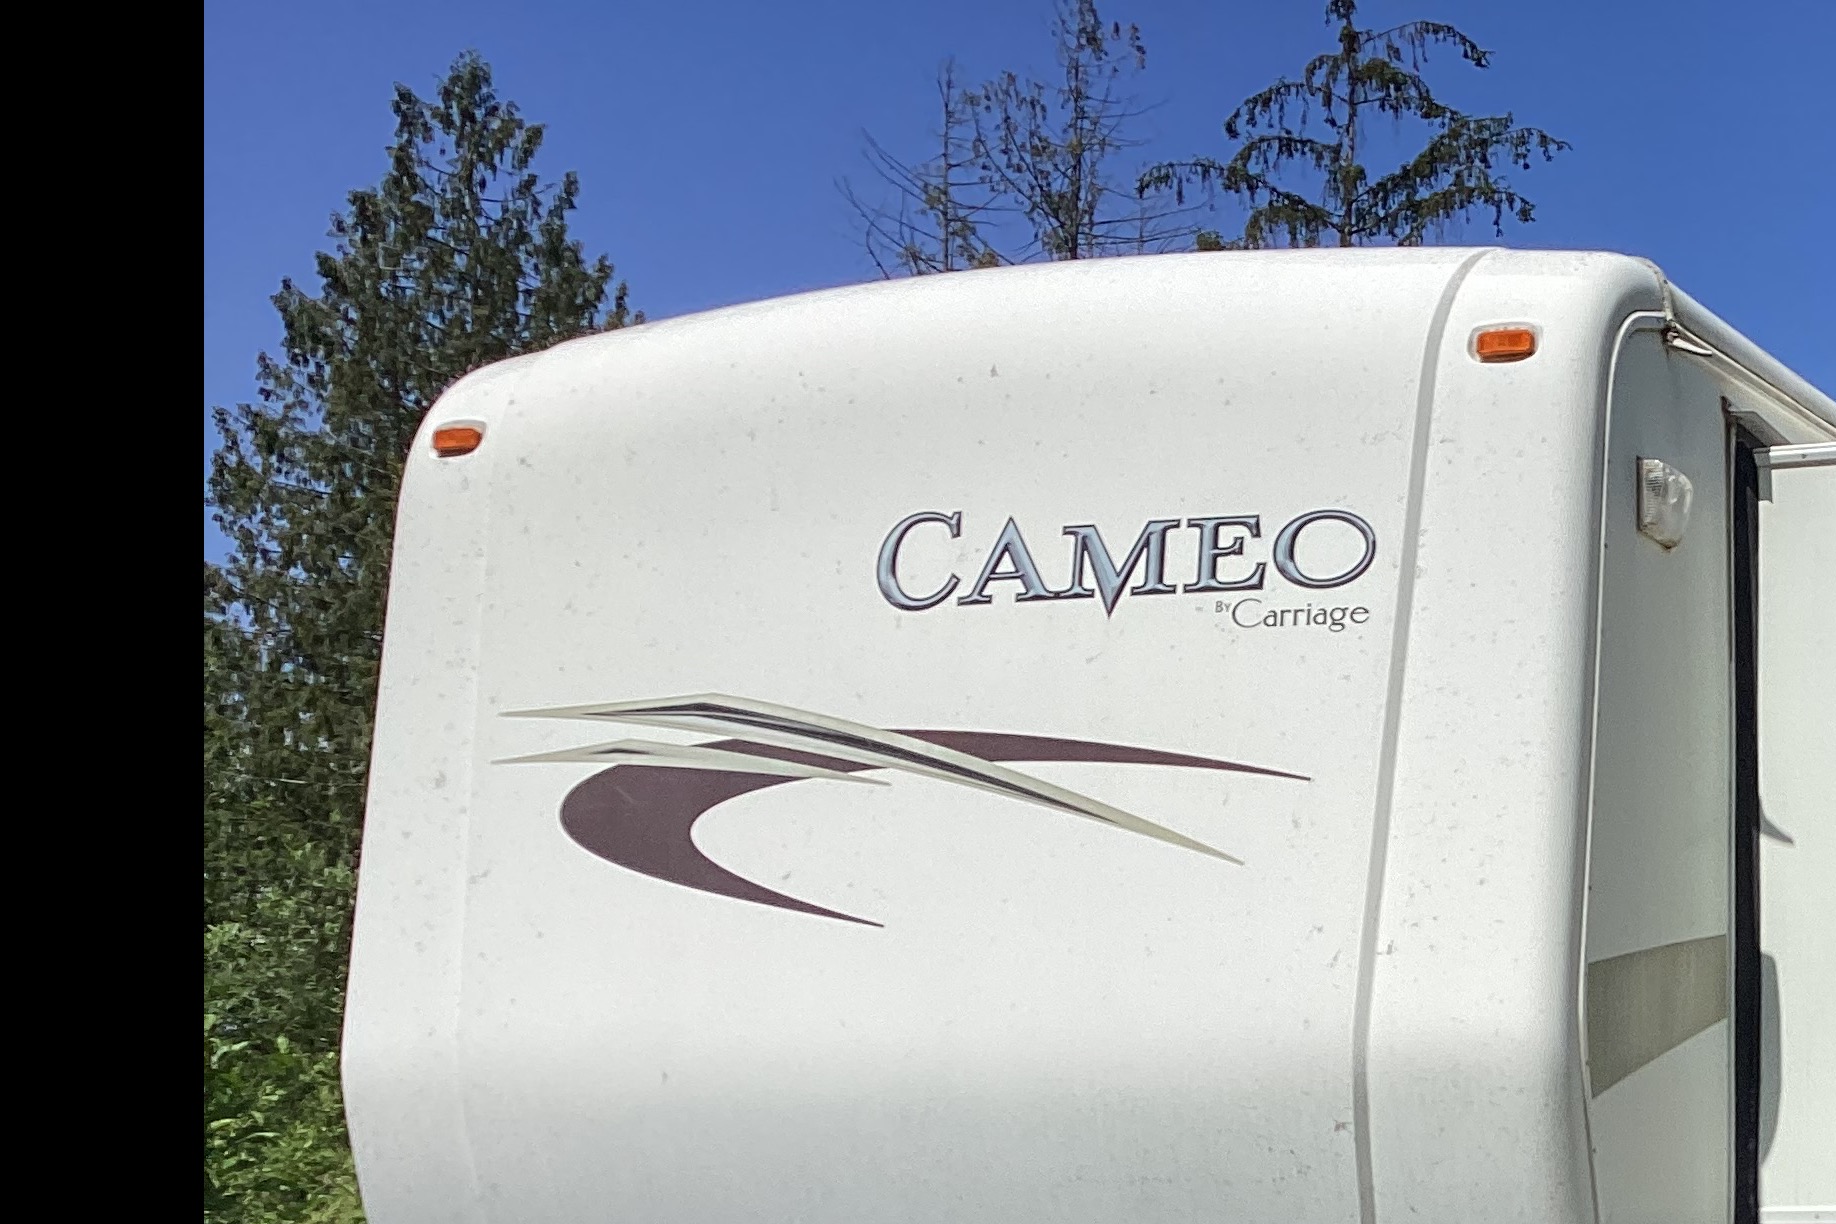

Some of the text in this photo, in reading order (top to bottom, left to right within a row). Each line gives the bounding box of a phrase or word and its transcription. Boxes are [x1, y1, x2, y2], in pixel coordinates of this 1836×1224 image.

[876, 508, 1377, 619] CAMEO
[1214, 597, 1370, 633] BY Carriage
